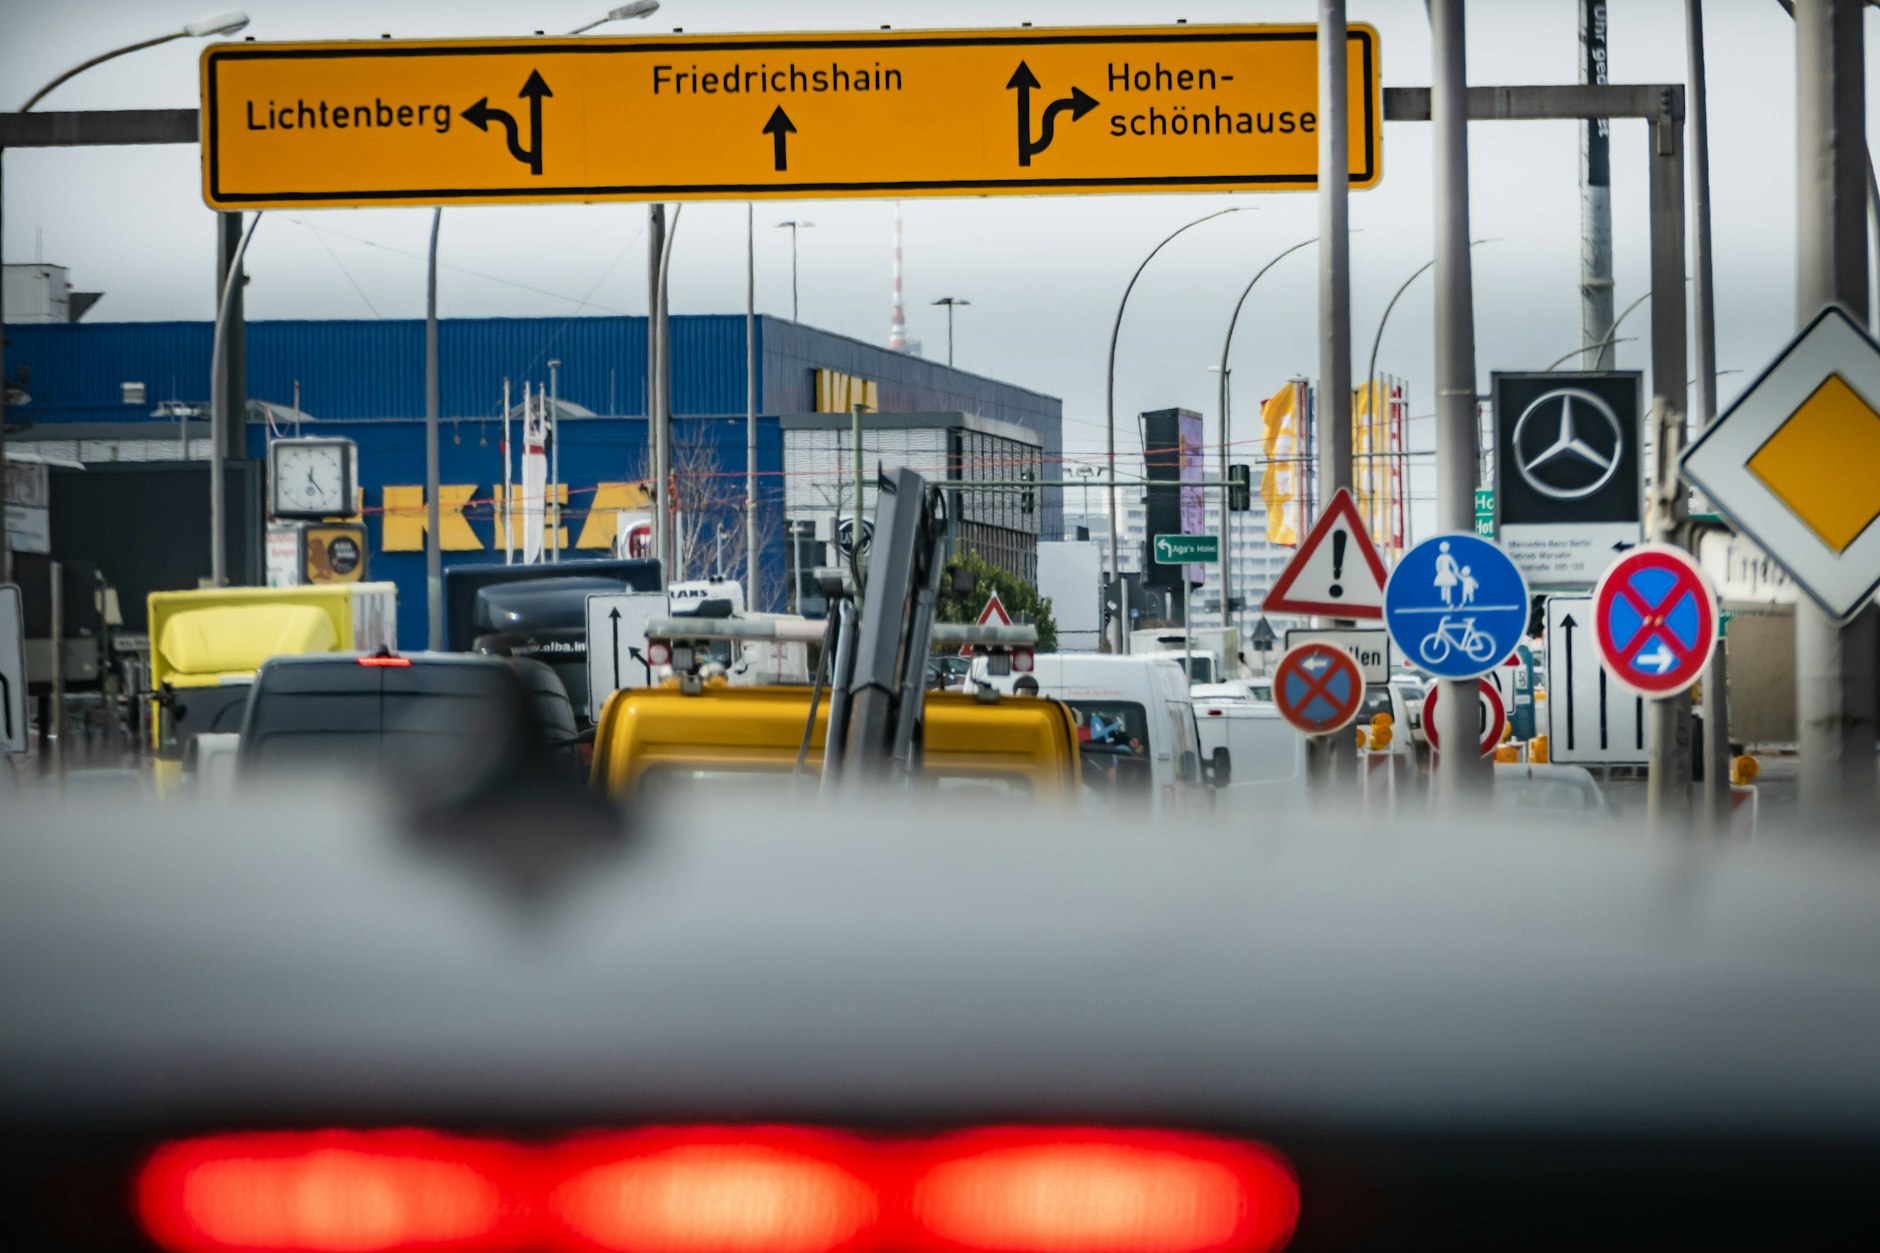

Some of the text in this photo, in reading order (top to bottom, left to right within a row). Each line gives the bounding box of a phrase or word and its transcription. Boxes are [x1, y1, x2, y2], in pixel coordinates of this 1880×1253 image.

[653, 62, 902, 94] Friedrichshain
[1107, 62, 1234, 91] Hohen-
[247, 98, 451, 133] Lichtenberg
[1110, 105, 1317, 136] schönhause
[357, 482, 657, 551] KEA
